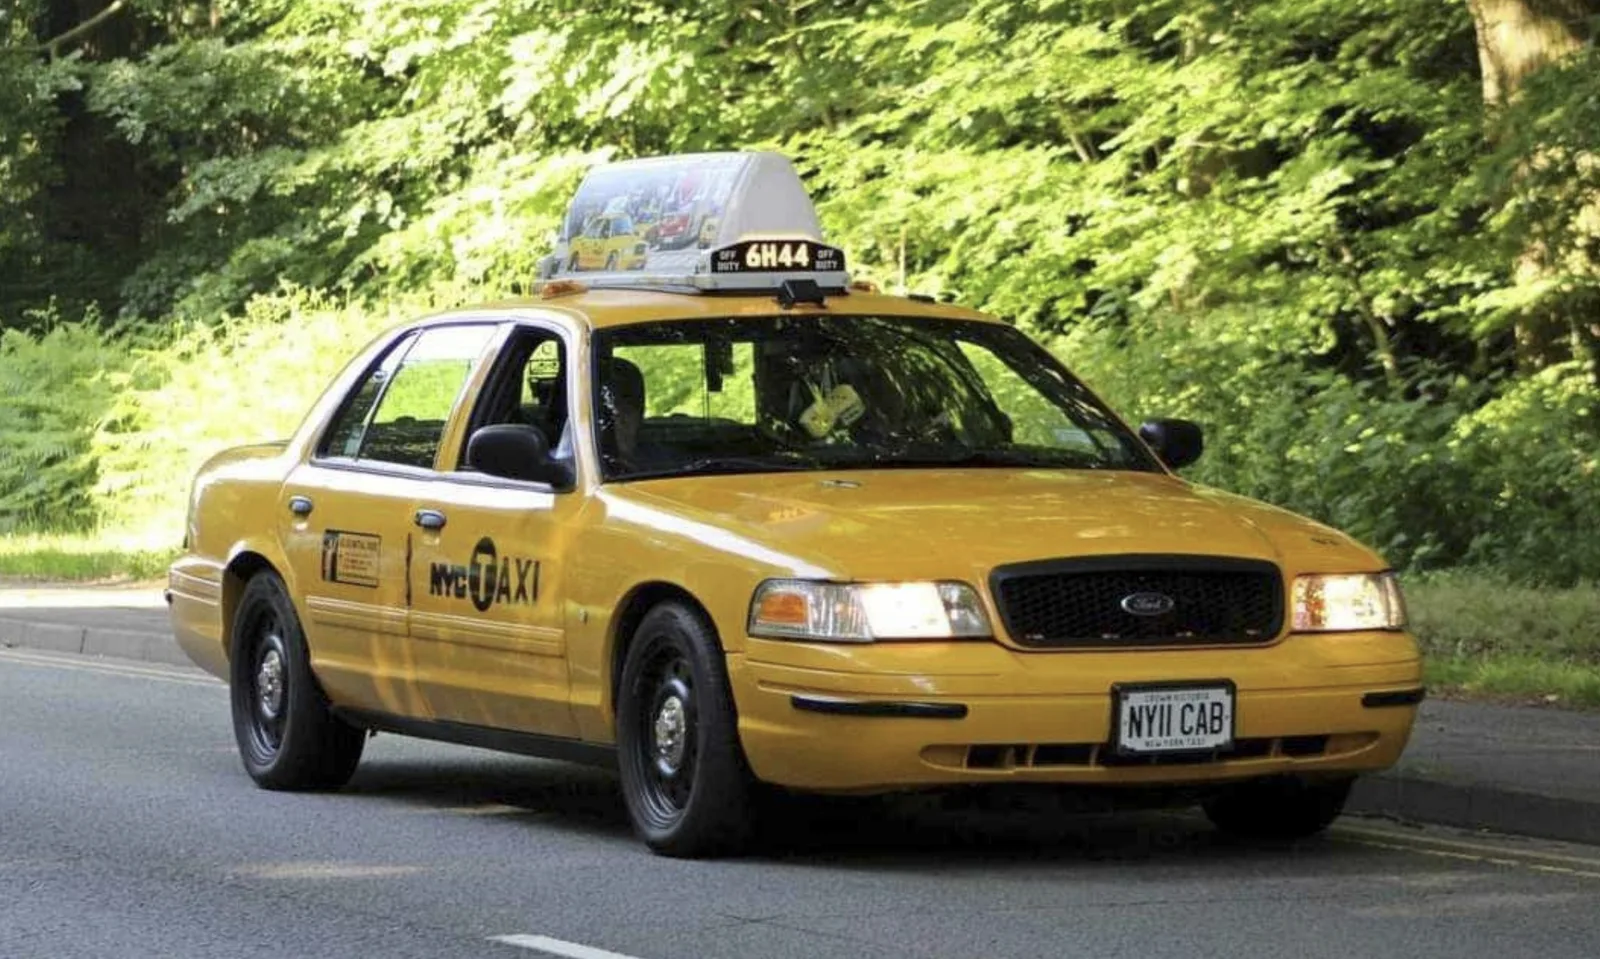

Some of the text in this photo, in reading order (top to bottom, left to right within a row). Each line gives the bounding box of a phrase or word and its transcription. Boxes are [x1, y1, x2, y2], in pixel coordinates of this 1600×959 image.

[719, 250, 737, 260] OFF
[745, 243, 809, 267] 6H44
[817, 250, 835, 259] OFF
[717, 262, 739, 271] DUTY
[815, 261, 838, 269] DUTY
[1180, 702, 1224, 735] CAB
